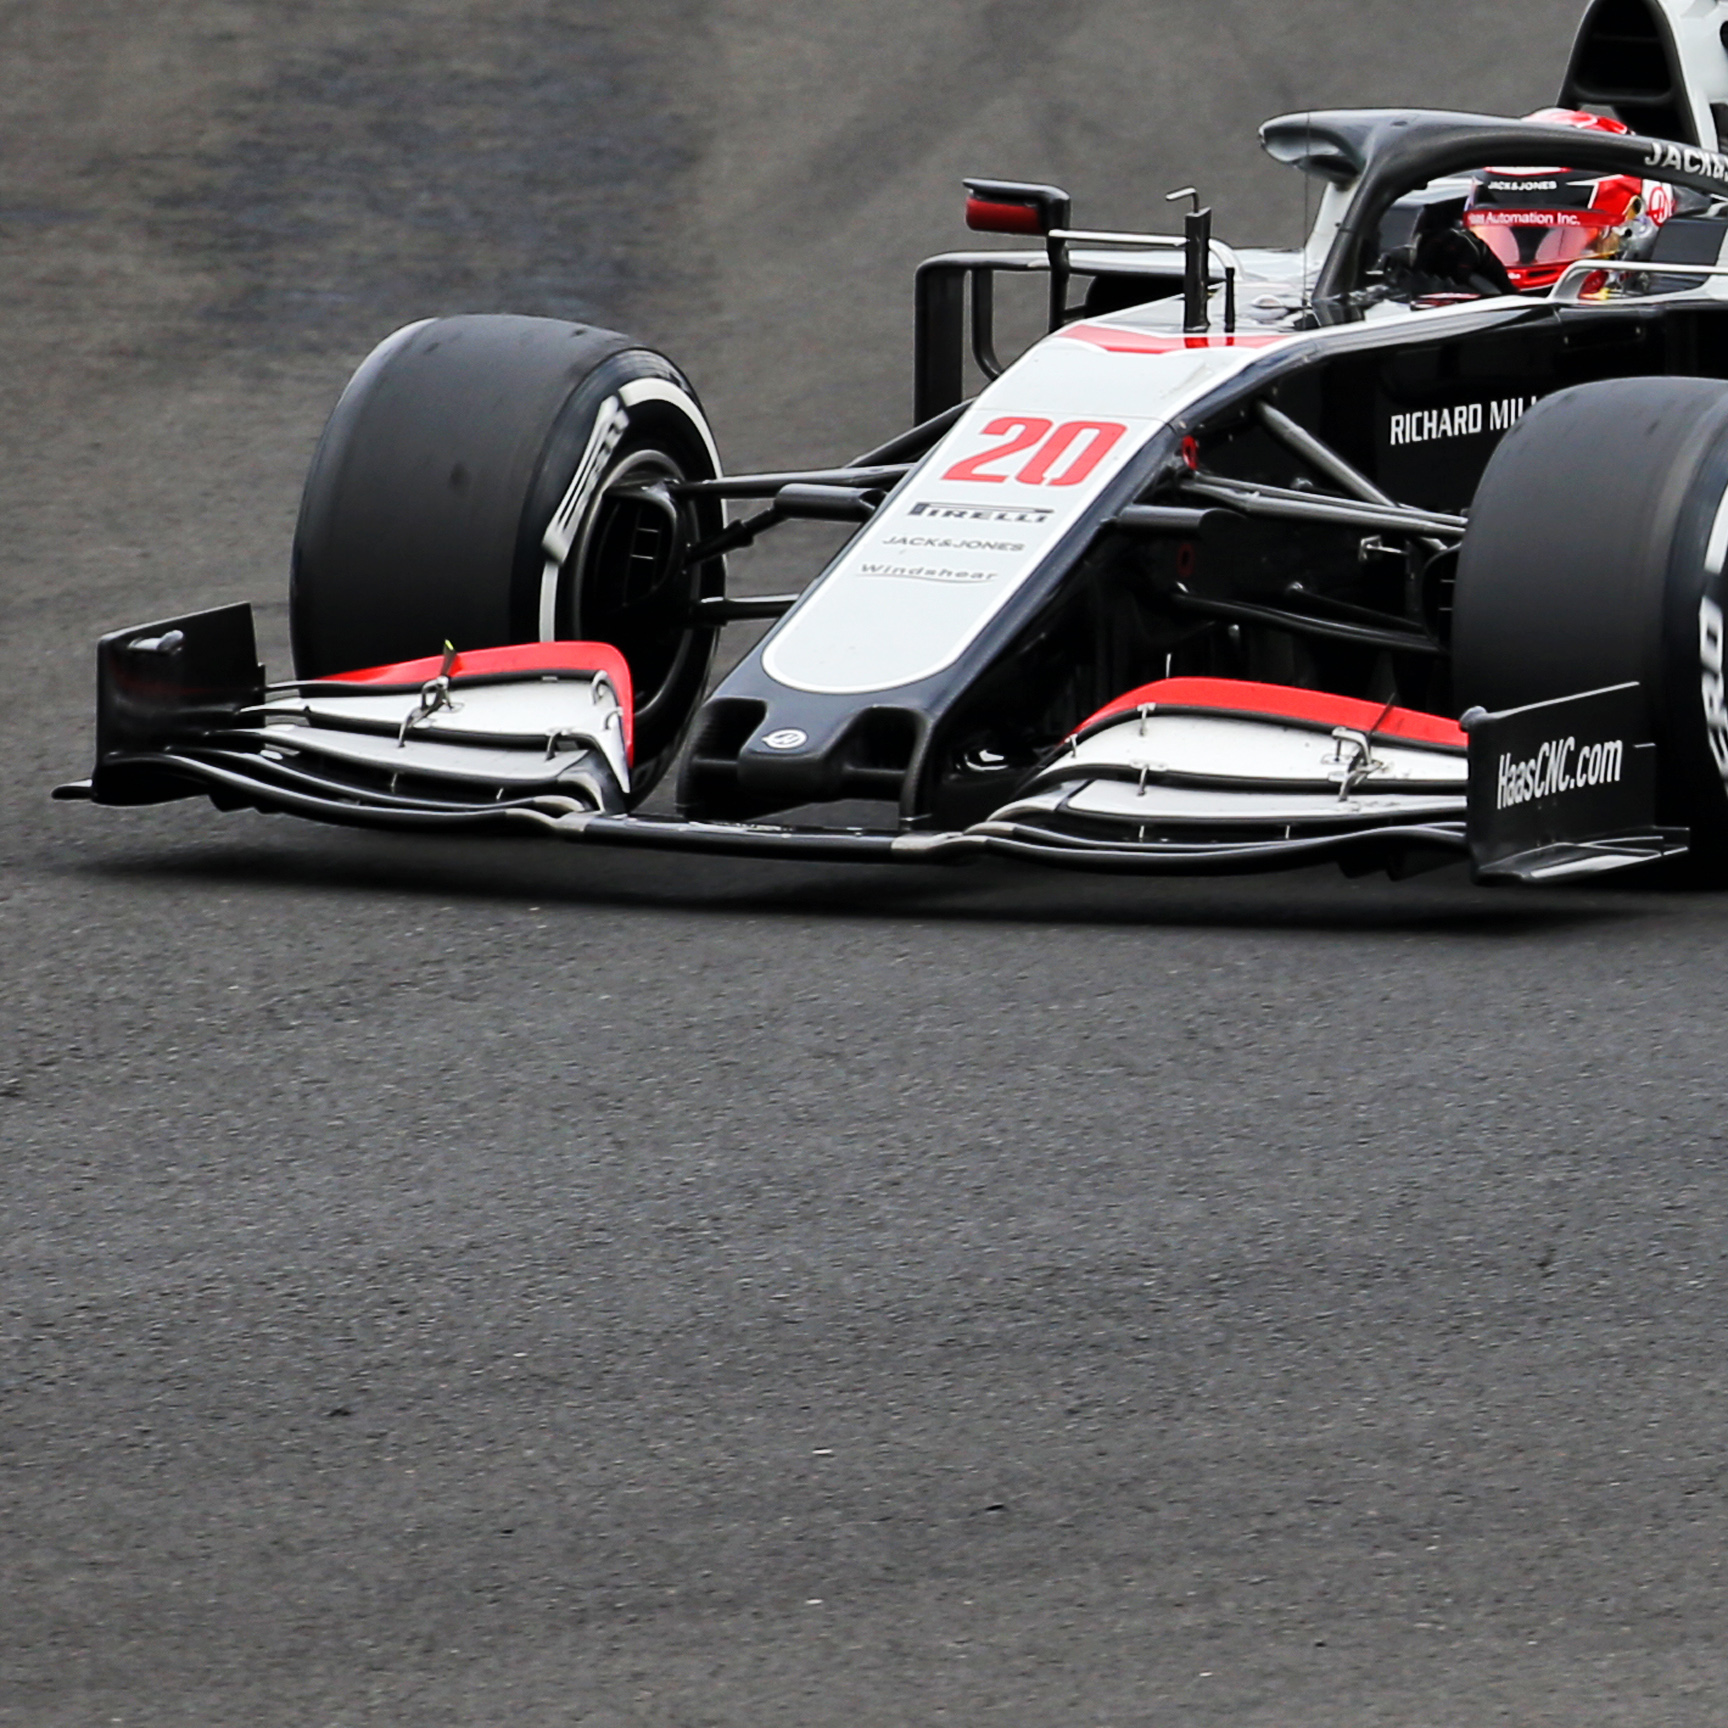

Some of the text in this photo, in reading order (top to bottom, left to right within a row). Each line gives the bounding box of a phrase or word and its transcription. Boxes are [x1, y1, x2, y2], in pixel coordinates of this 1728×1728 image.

[1486, 211, 1553, 226] Automation
[1557, 212, 1581, 226] Inc.
[1390, 395, 1537, 446] RICHARD MIL
[940, 416, 1128, 487] 20
[907, 501, 1054, 523] PIRELLI
[881, 536, 1026, 552] JACK&JONES
[860, 563, 998, 581] Windshear
[1497, 735, 1623, 810] HaasCNC.com
